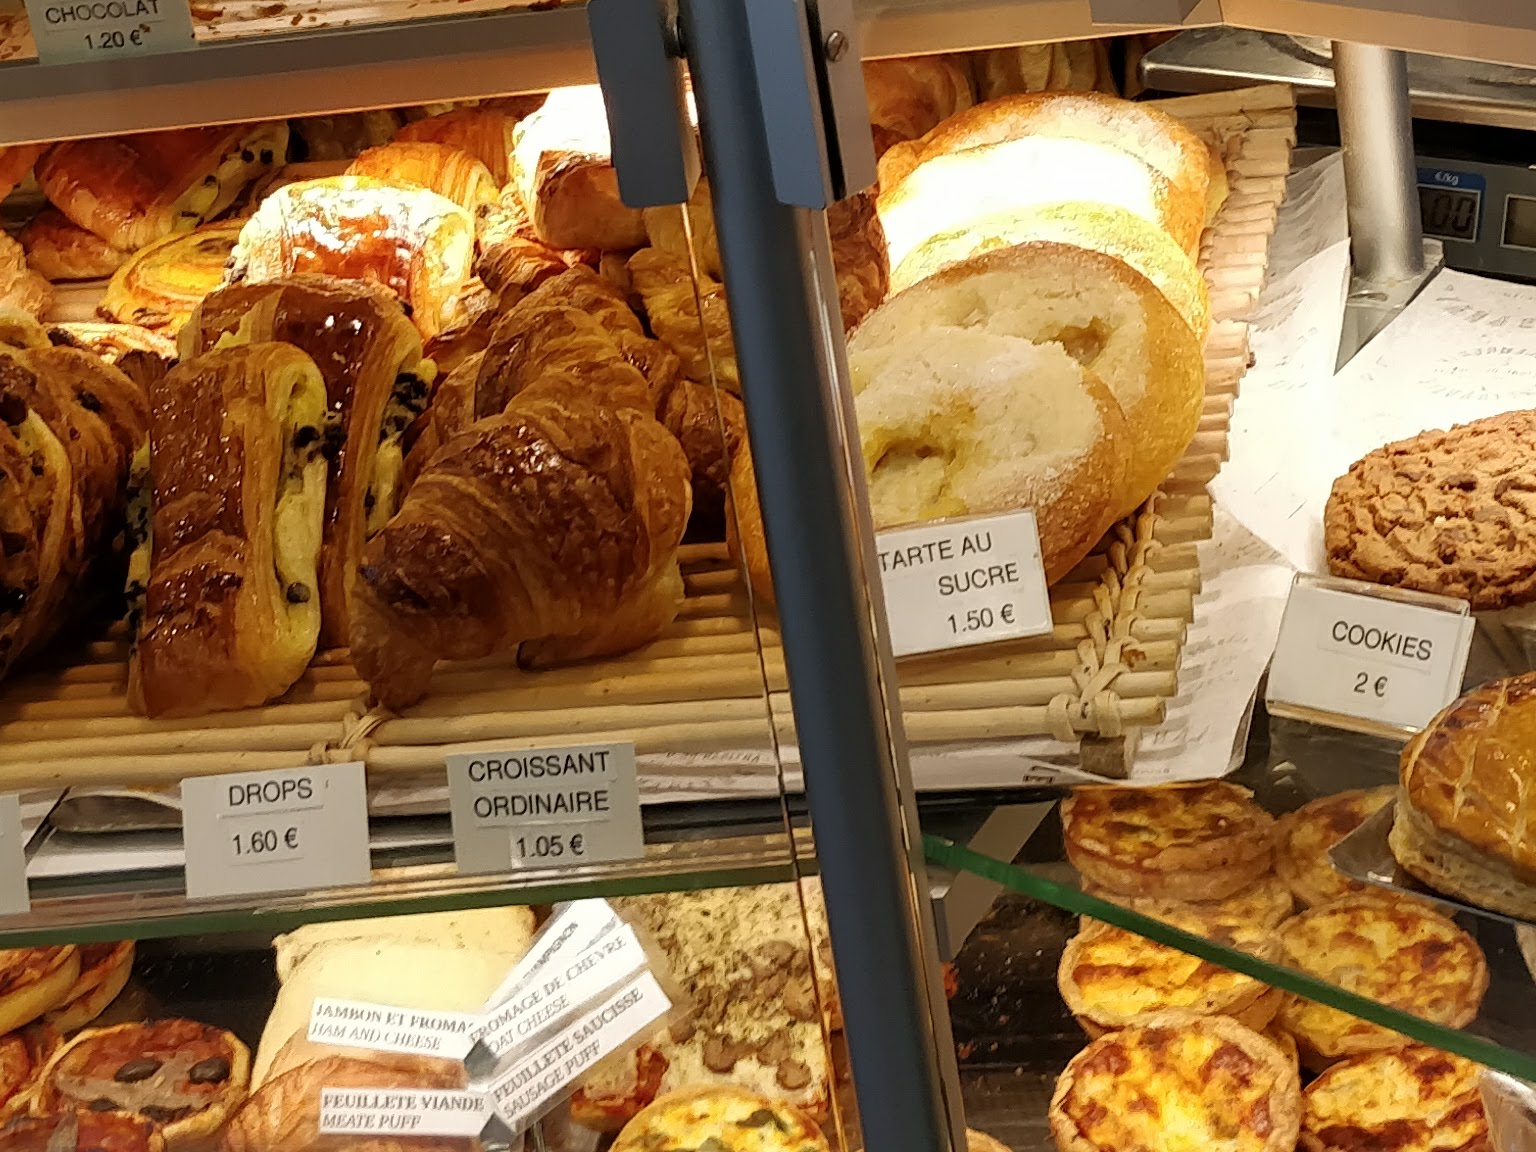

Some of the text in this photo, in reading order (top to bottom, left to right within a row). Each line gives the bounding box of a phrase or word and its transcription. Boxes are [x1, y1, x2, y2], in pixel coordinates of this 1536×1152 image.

[83, 28, 144, 51] 1.20 €
[878, 532, 992, 573] TARTE AU
[938, 562, 1020, 596] SUCRE
[947, 603, 1016, 634] 1.50 €
[1332, 620, 1433, 661] COOKIES
[1353, 671, 1389, 697] 2 €
[468, 750, 611, 783] CROISSANT
[227, 777, 314, 808] DROPS
[473, 790, 611, 820] ORDINAIRE
[231, 827, 300, 856] 1.60 €
[515, 833, 586, 859] 1.05 €
[542, 972, 566, 1000] DE
[564, 934, 630, 983] CHEVRE
[316, 1003, 476, 1036] JAMBON ET FROMA
[487, 992, 571, 1057] OAT CHEESE
[312, 1022, 443, 1051] HAM AND CHEESE
[491, 985, 645, 1103] FEUILLETE SAUCISSE
[501, 1038, 604, 1121] SAUSAGE PUFF
[322, 1092, 486, 1113] FEUILLETE VIANDE
[322, 1113, 423, 1131] MEATE PUFF
